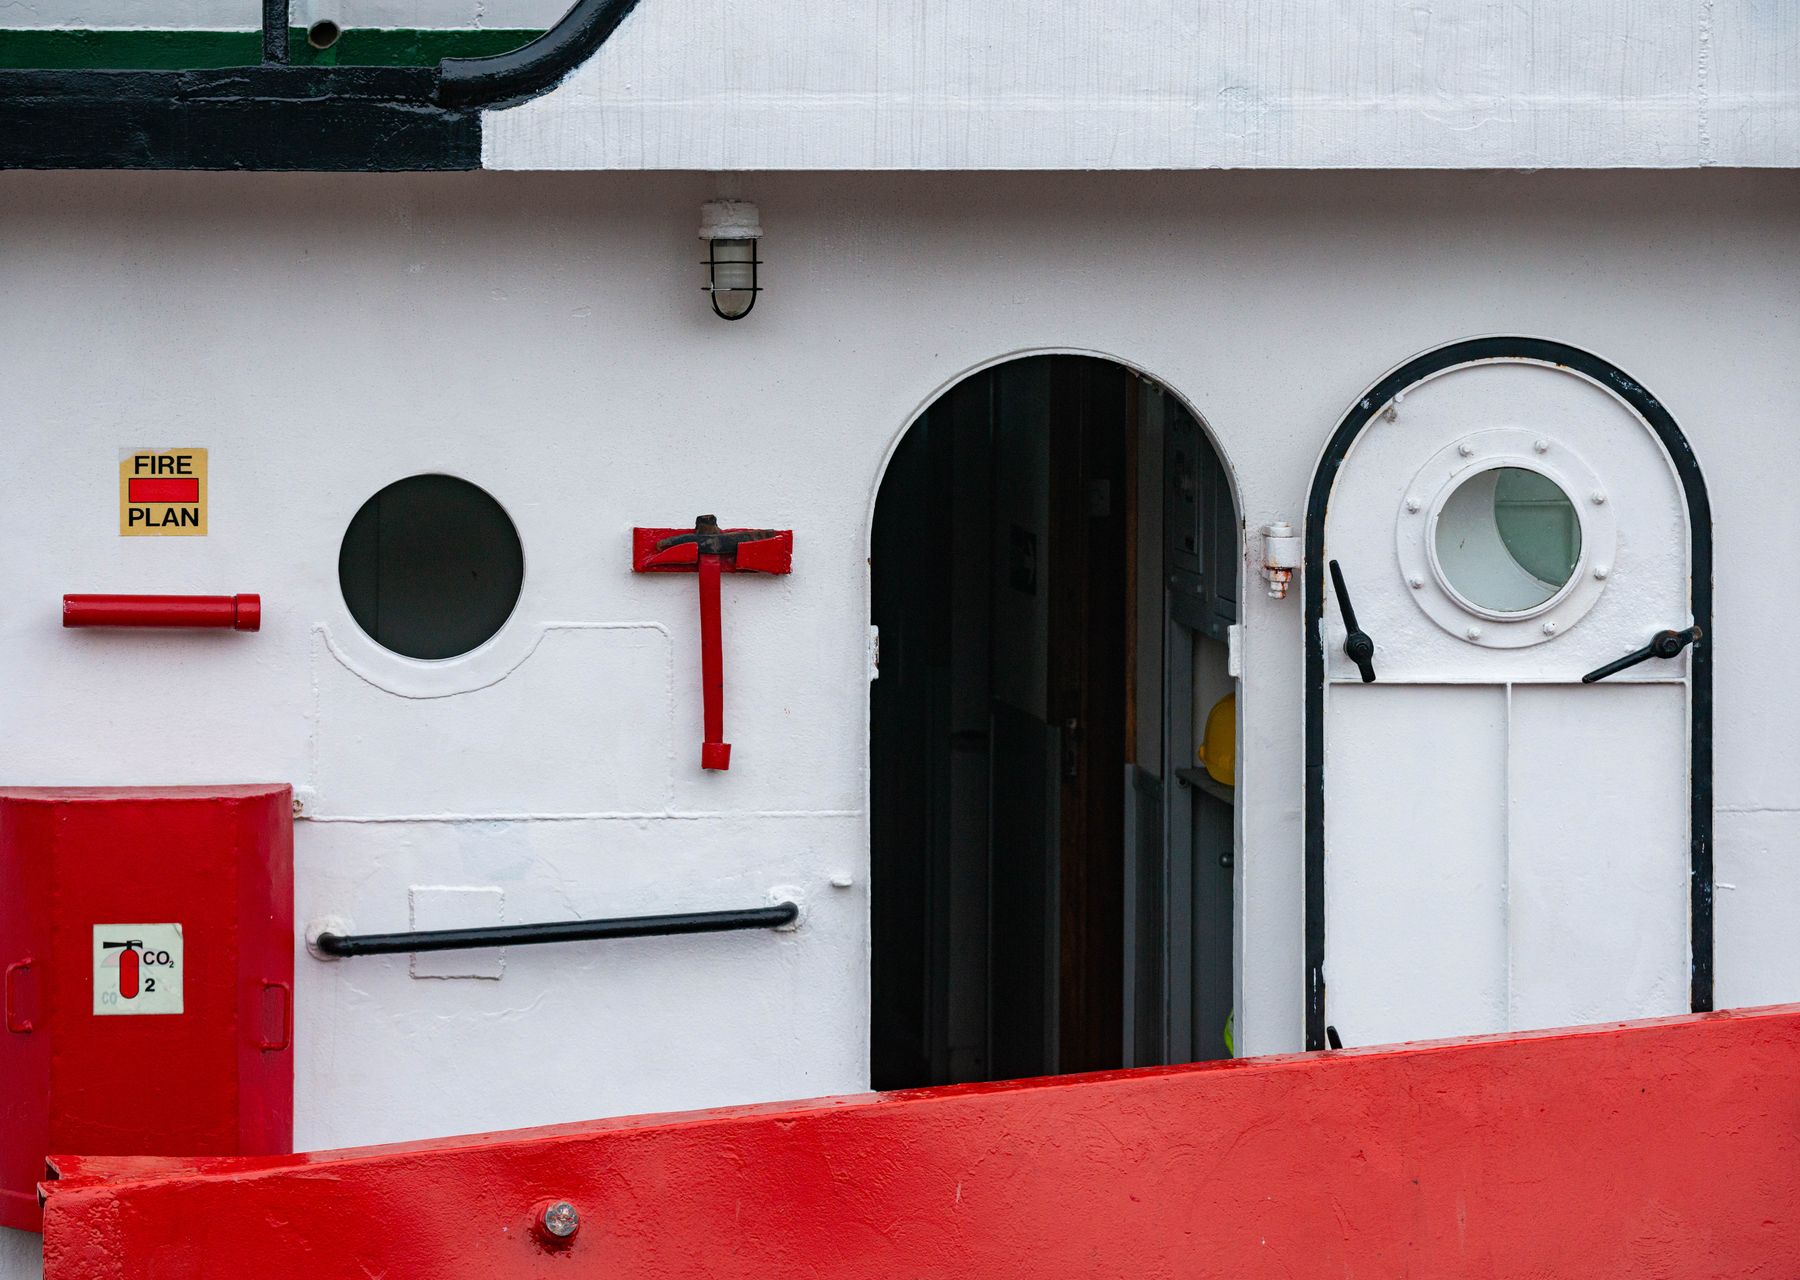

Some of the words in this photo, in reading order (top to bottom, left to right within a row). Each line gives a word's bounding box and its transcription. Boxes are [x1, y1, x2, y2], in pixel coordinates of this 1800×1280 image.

[134, 455, 193, 475] FIRE
[128, 507, 199, 527] PLAN
[144, 977, 156, 992] 2
